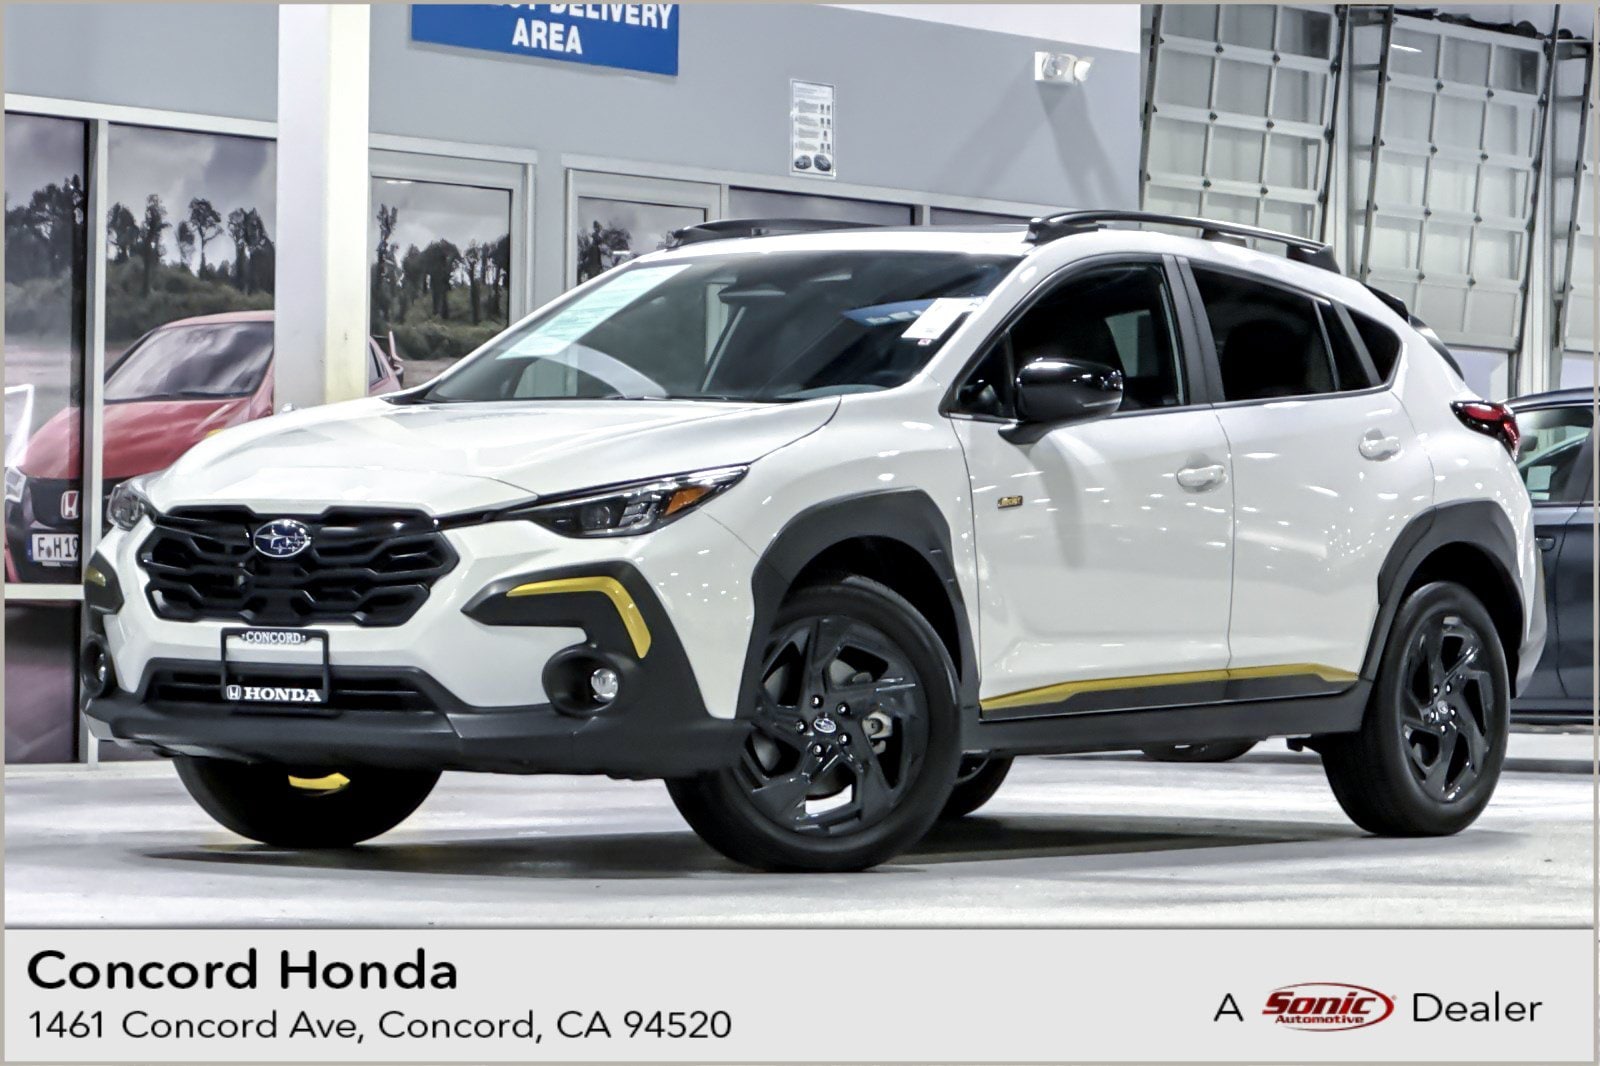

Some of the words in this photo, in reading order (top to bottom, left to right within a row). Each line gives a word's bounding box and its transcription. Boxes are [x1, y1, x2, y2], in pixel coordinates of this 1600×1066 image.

[511, 18, 583, 55] AREA
[245, 631, 302, 643] CONCORD
[243, 686, 322, 702] HONDA
